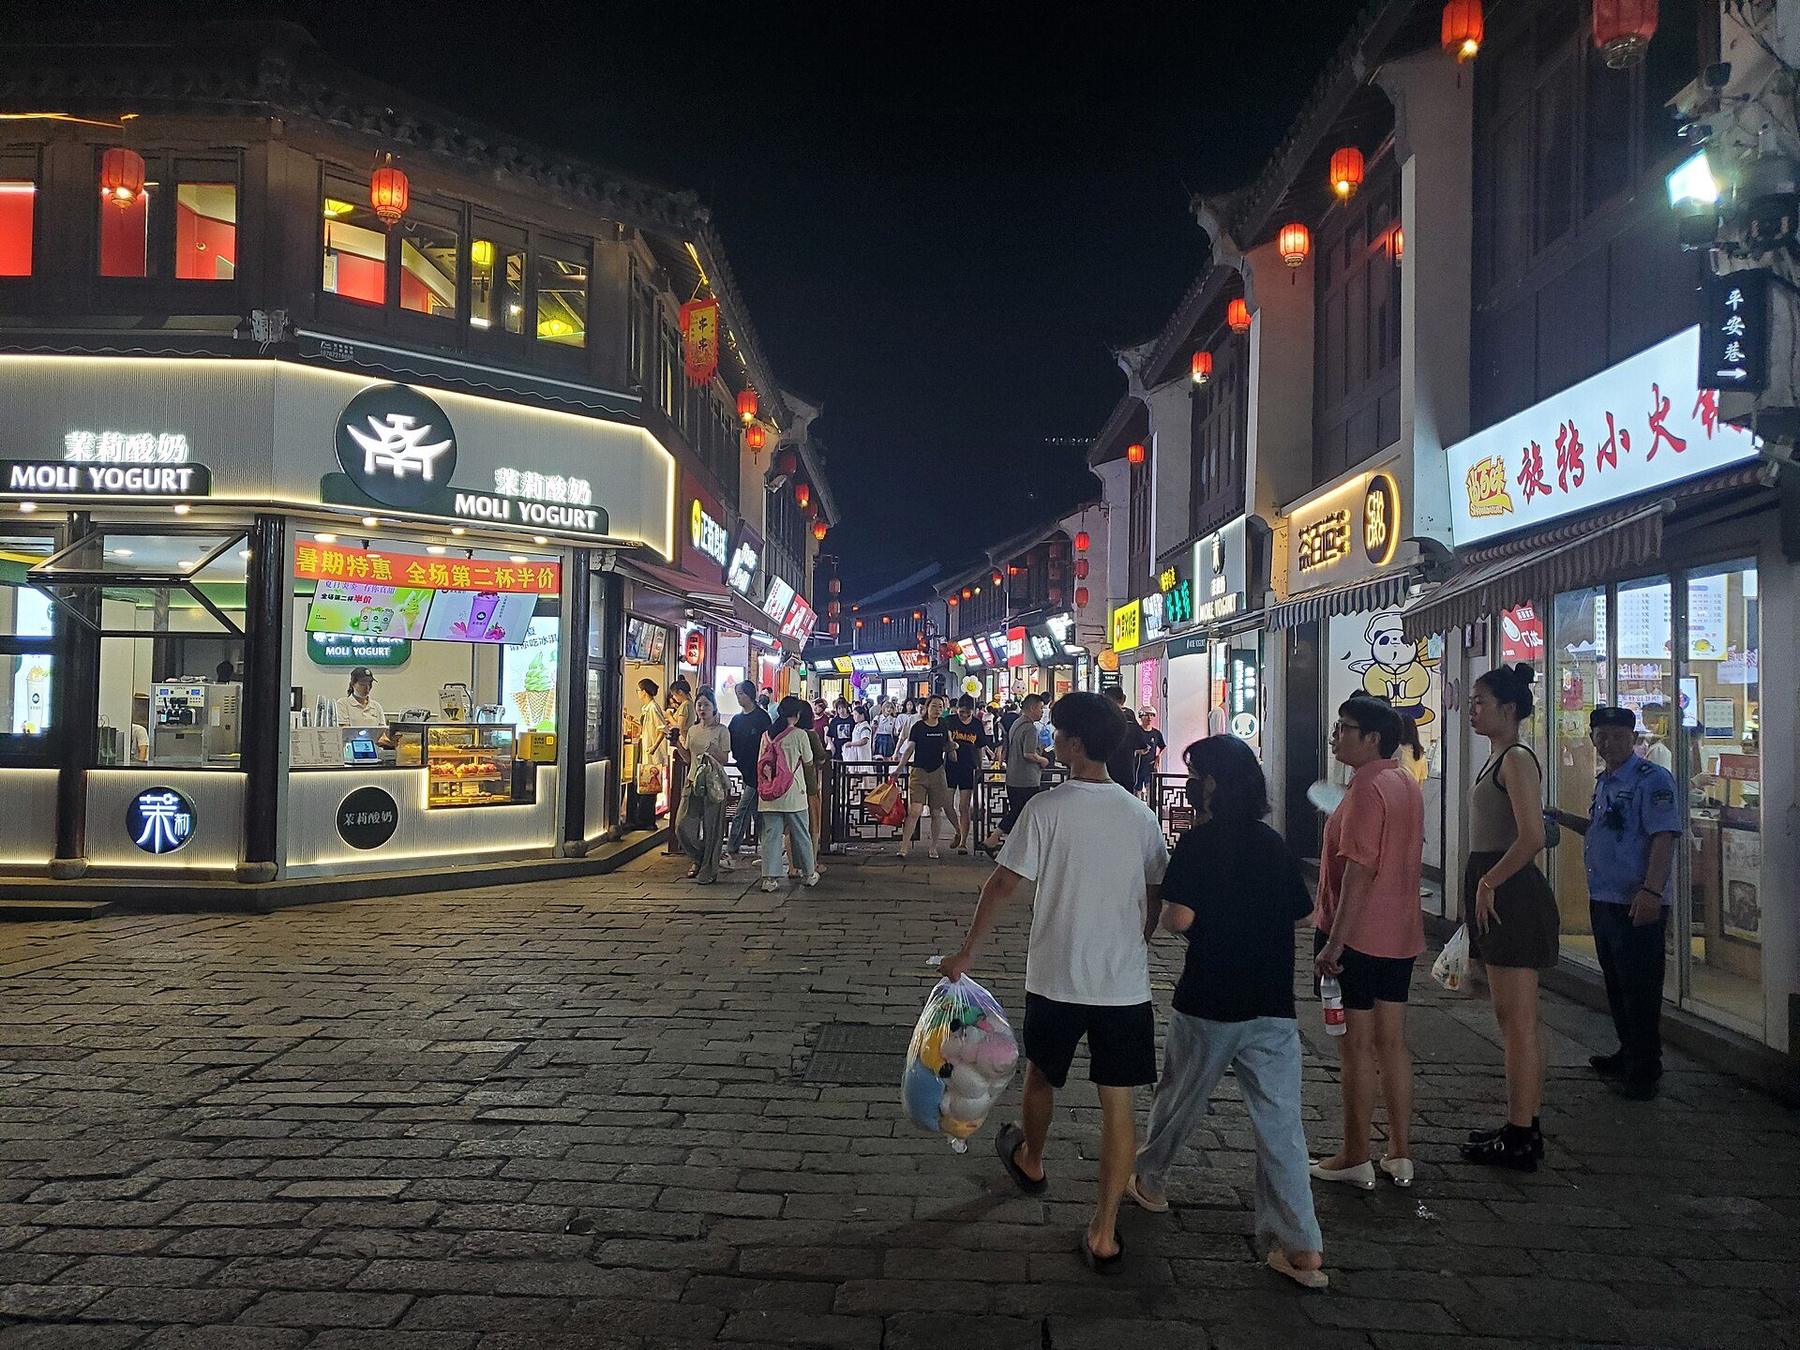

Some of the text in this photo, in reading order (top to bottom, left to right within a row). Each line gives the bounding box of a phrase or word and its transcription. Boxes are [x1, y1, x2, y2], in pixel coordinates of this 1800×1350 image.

[1722, 288, 1746, 362] 平安巷
[64, 431, 188, 462] 茉莉酸奶
[9, 465, 195, 491] MOLI YOGURT
[455, 494, 598, 530] MOLI YOGURT
[296, 547, 555, 590] 暑期特惠 全场第二杯半价
[320, 592, 373, 605] 全场第二杯半价
[325, 646, 391, 657] MOLI YOGURT
[343, 810, 393, 826] 茉莉酸奶
